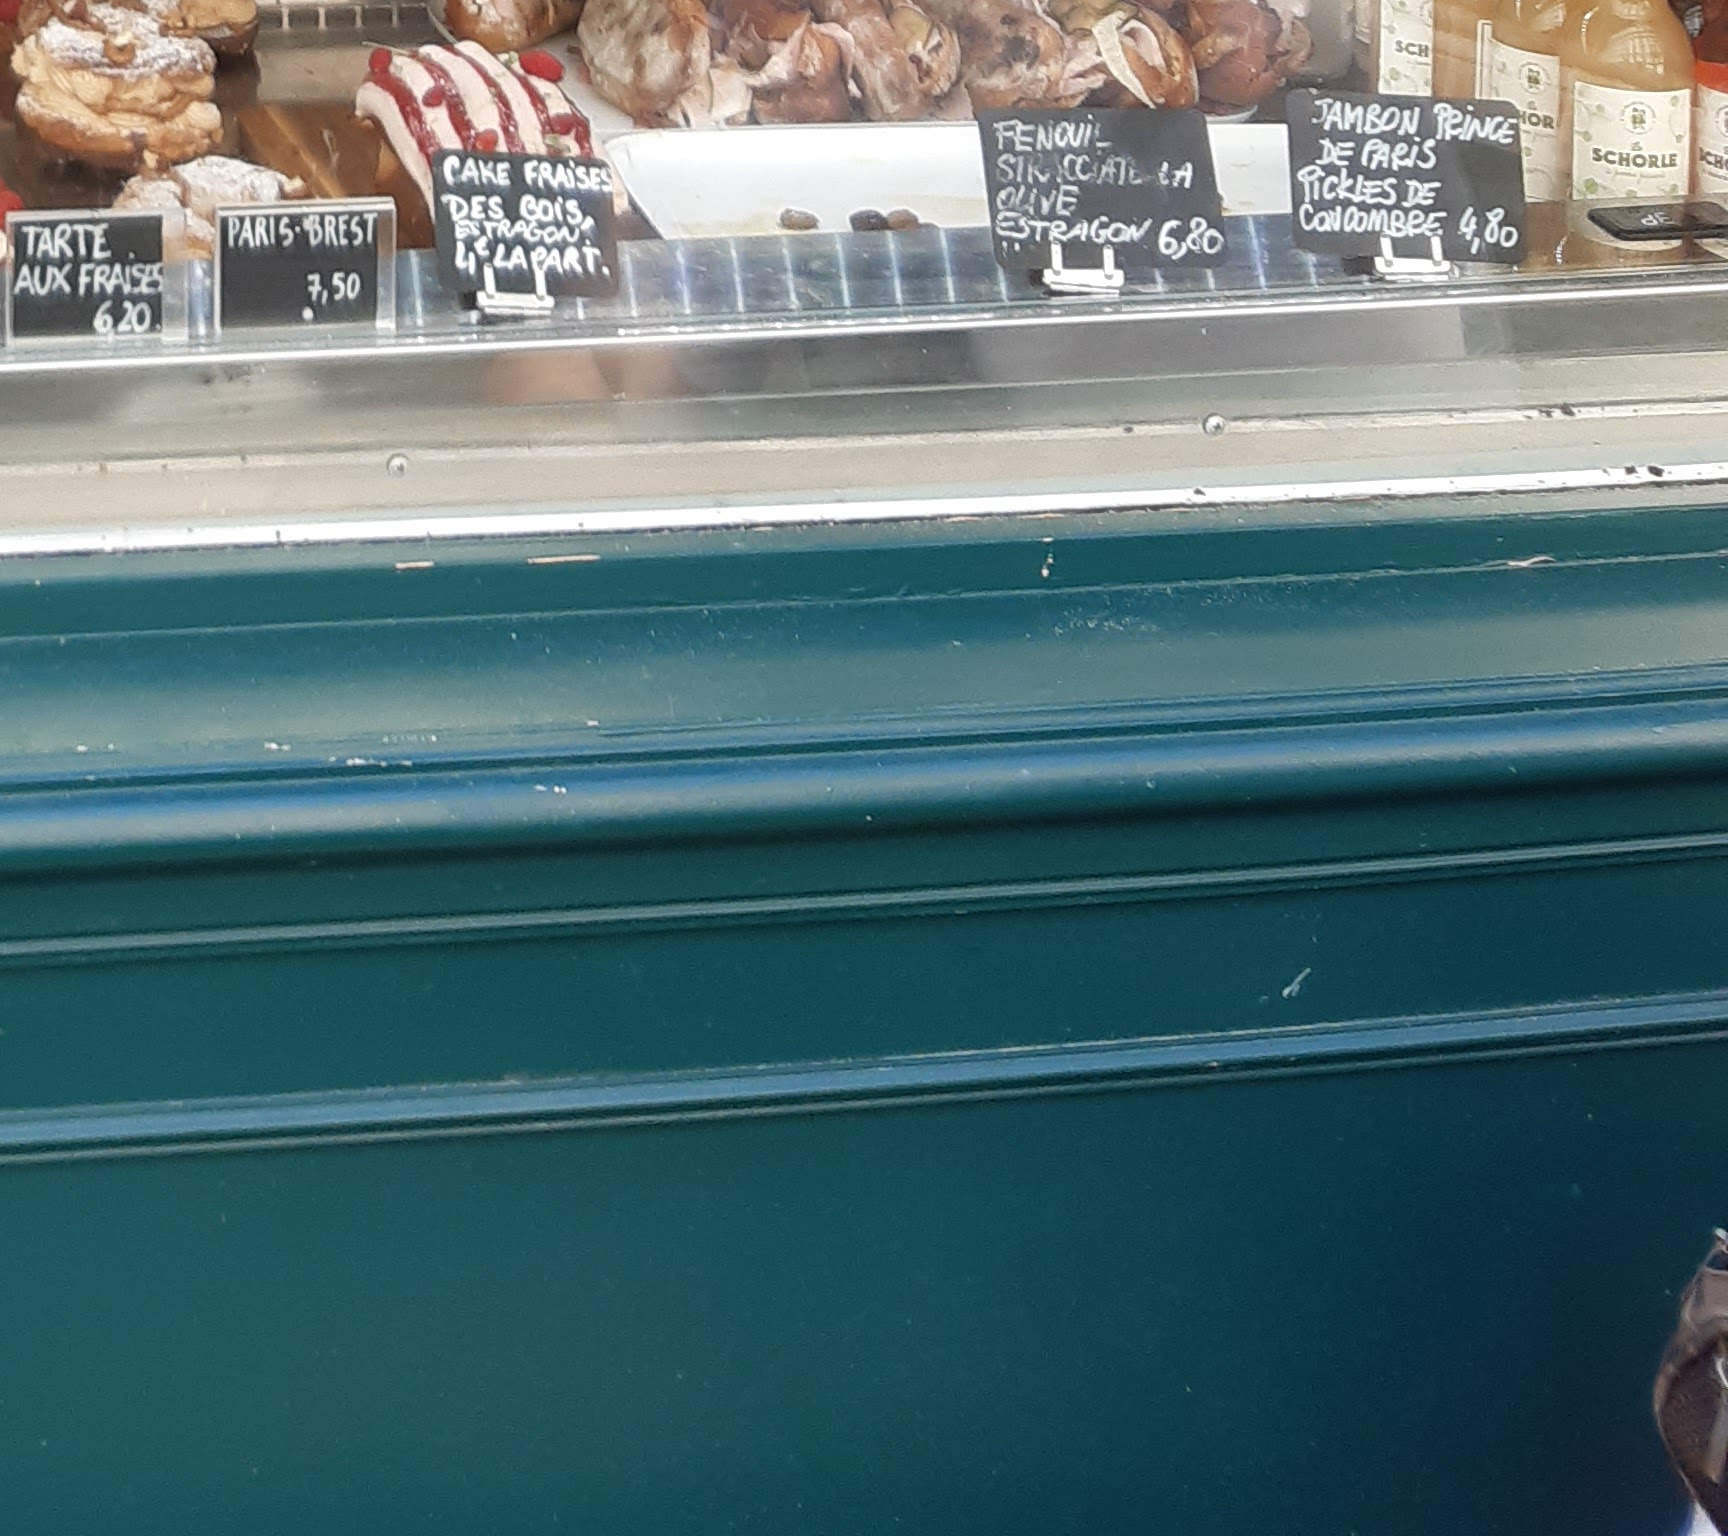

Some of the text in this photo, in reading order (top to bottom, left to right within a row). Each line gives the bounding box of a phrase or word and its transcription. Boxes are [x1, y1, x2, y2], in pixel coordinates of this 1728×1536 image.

[1311, 98, 1421, 136] JAMBON
[1432, 102, 1518, 144] PRINCE
[1315, 135, 1438, 171] DE PARIS
[1591, 146, 1679, 169] SCHORLE
[442, 154, 614, 191] CAKE FRAISES
[1296, 165, 1442, 207] PICKLES DE
[440, 193, 505, 221] DES
[996, 184, 1081, 216] OLIVE
[21, 222, 112, 261] TARTE
[453, 219, 580, 244] ESTRAGON
[995, 210, 1225, 260] ESTRAGON 6,80
[1458, 206, 1518, 255] 4,80
[492, 244, 529, 270] LA
[13, 263, 73, 296] AUX
[305, 270, 362, 305] 7,50
